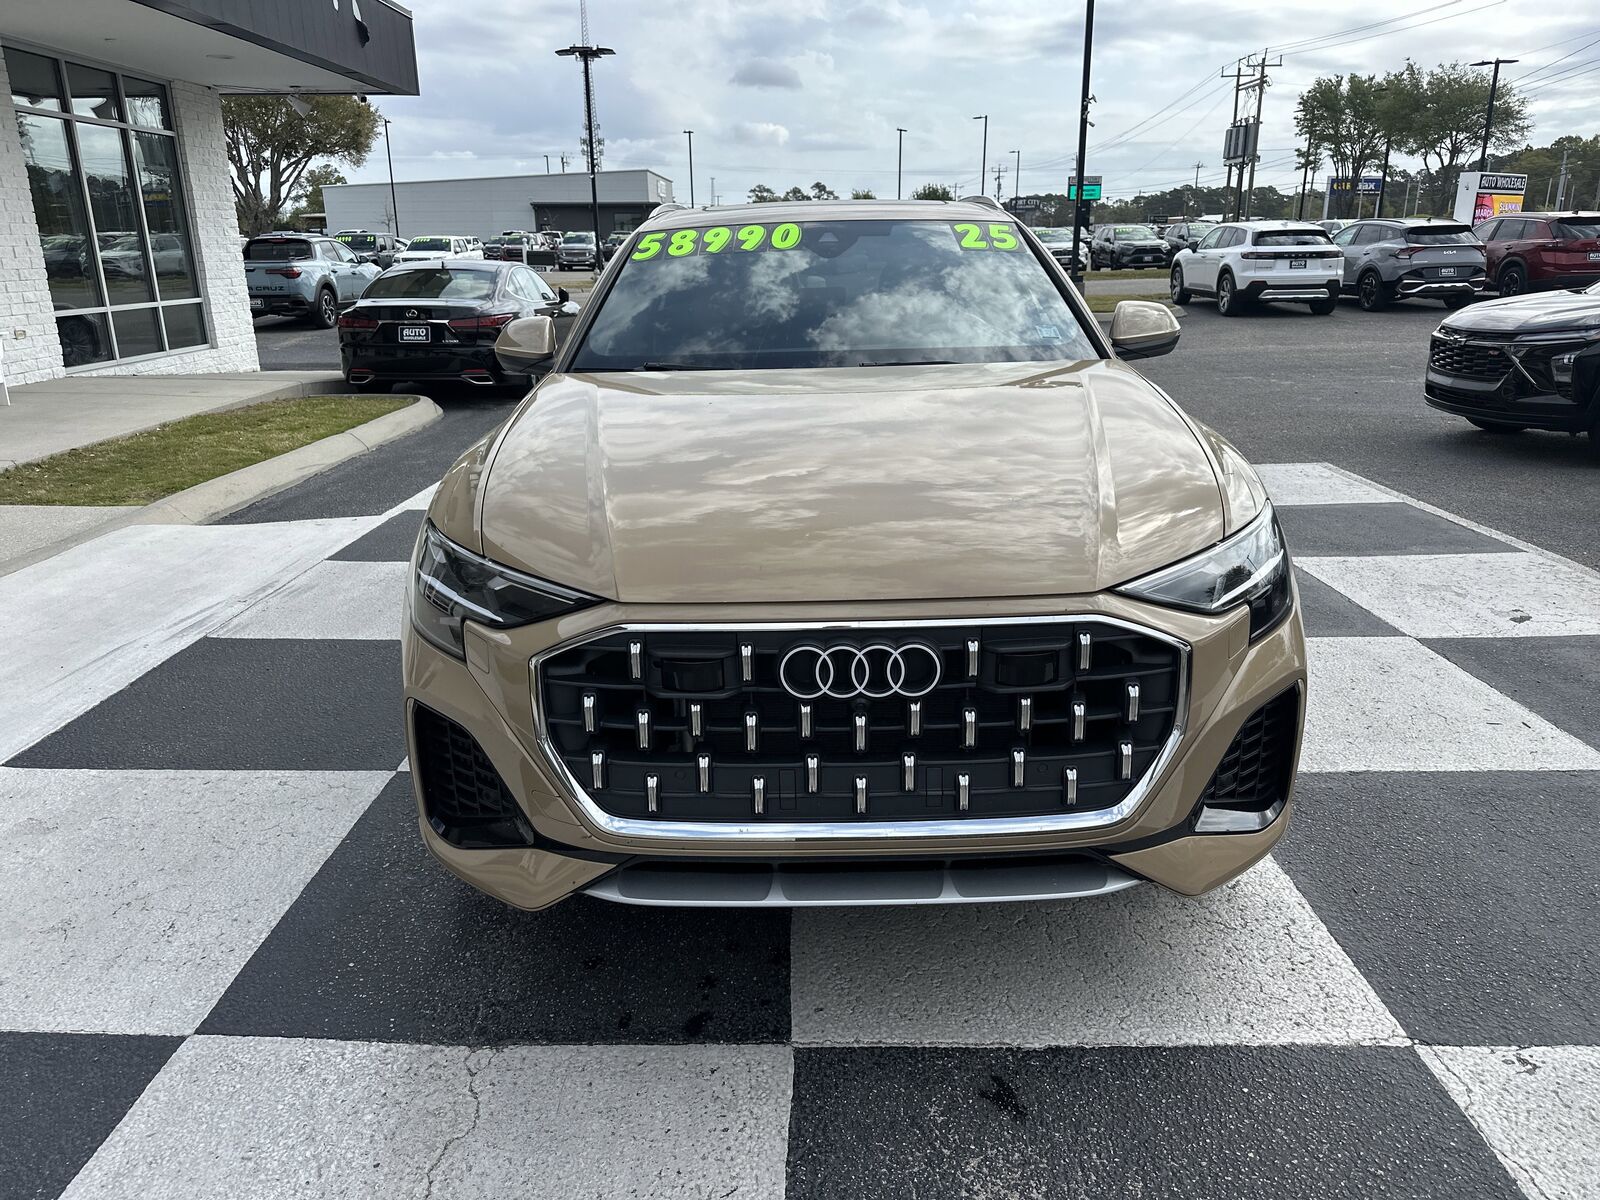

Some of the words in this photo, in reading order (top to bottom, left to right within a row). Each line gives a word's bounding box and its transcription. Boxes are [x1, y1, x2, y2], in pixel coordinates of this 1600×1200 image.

[1481, 176, 1496, 188] AUTO
[1496, 177, 1526, 189] WHOLESALE
[631, 222, 802, 262] 58990
[953, 223, 1019, 251] 25
[403, 328, 426, 336] AUTO
